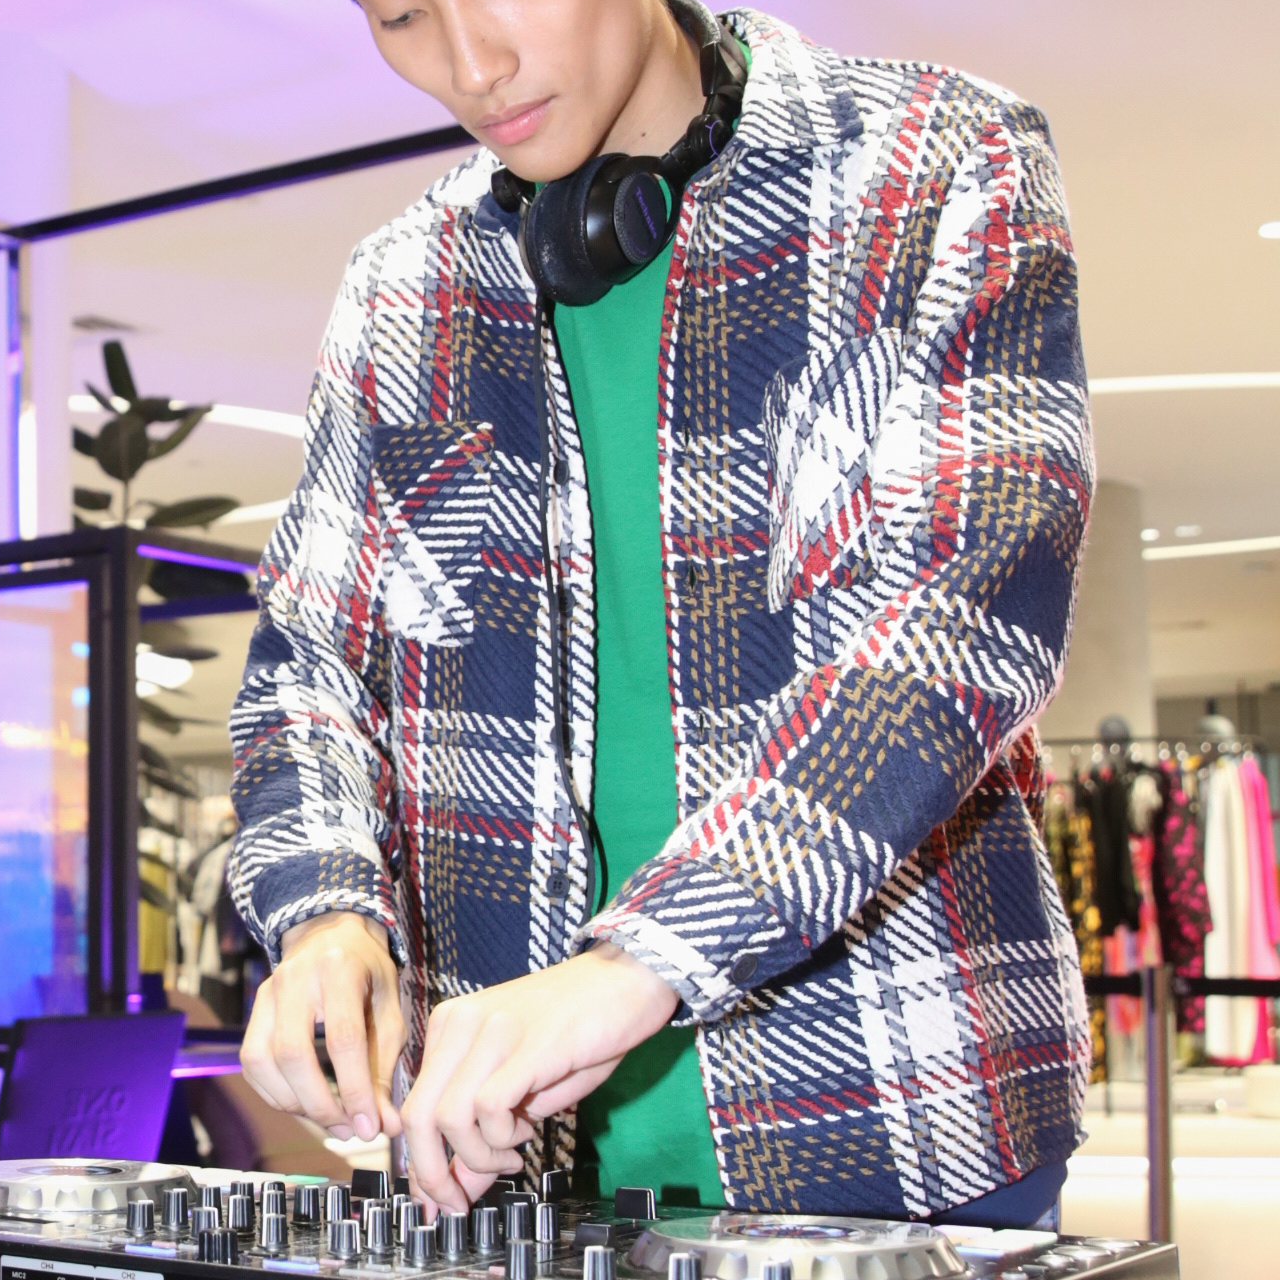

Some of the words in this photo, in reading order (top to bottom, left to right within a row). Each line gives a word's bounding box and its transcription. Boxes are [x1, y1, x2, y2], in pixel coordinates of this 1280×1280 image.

[41, 1262, 54, 1271] CH4
[11, 1271, 27, 1280] MIC2
[121, 1272, 136, 1280] CH2
